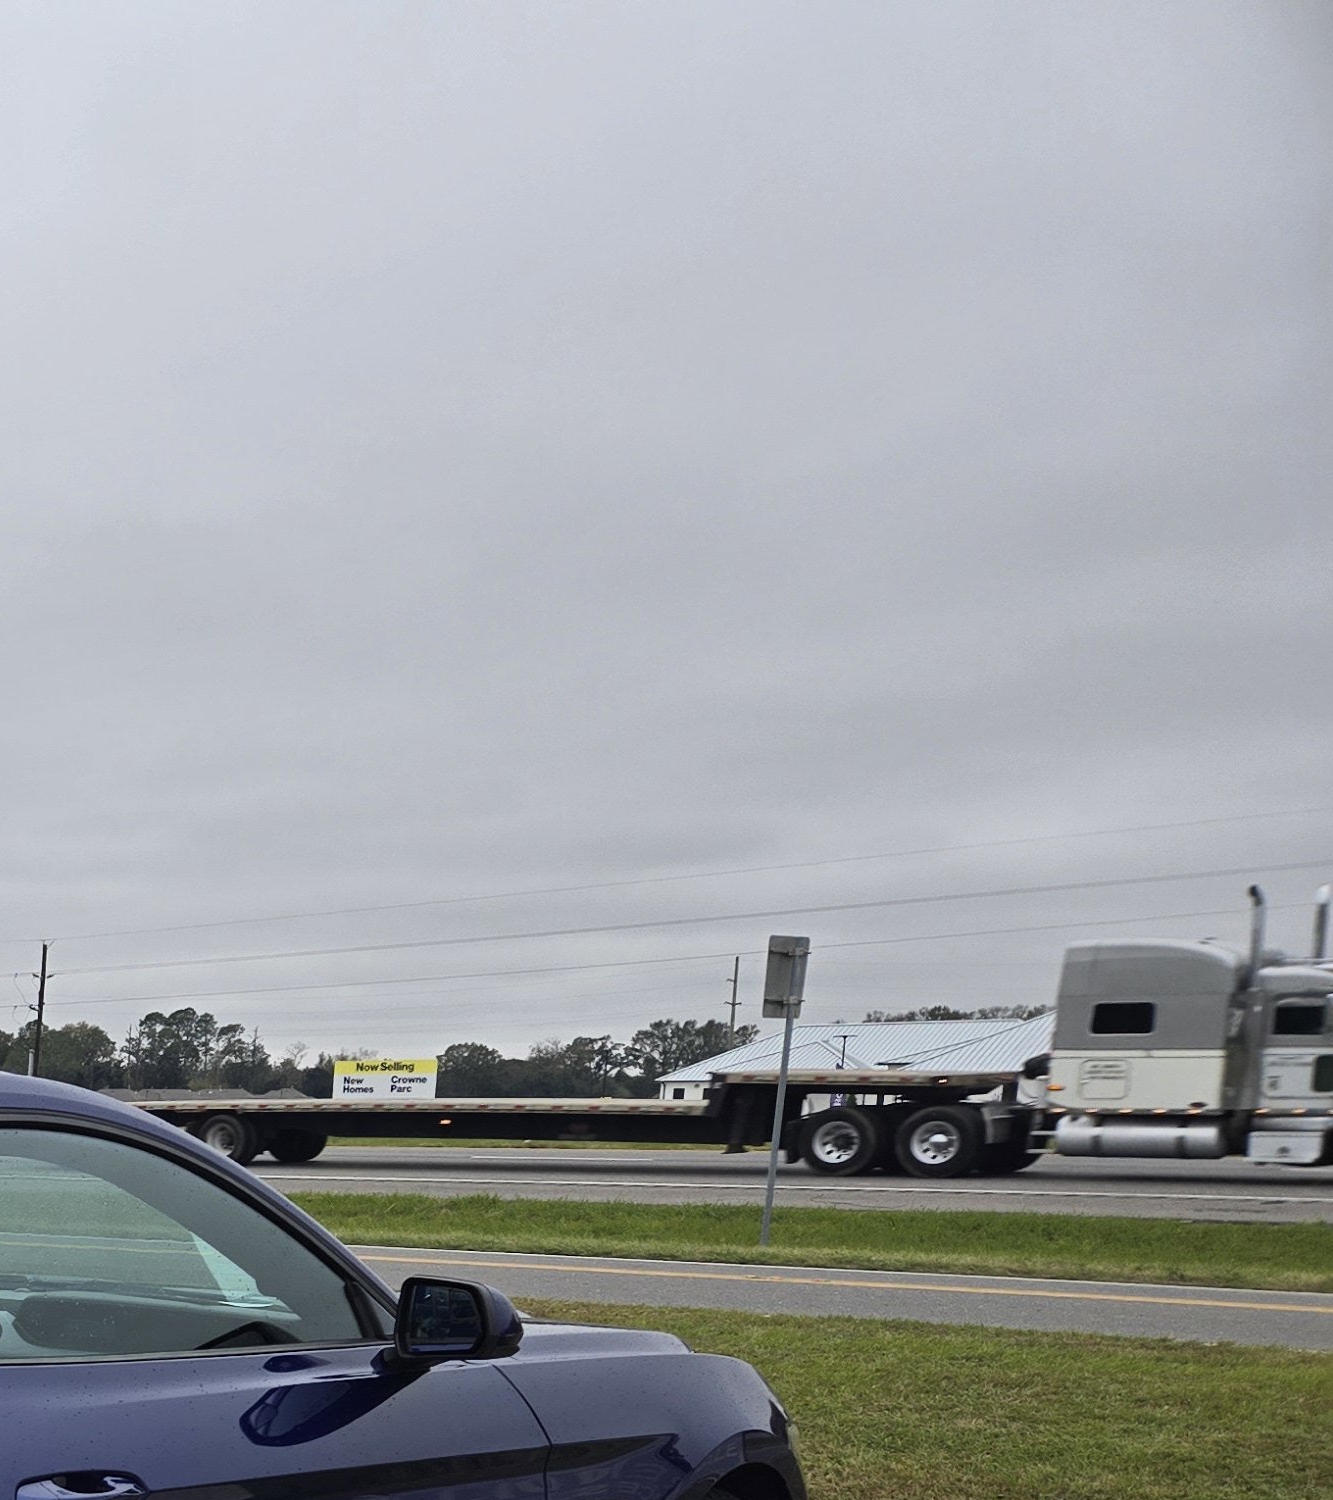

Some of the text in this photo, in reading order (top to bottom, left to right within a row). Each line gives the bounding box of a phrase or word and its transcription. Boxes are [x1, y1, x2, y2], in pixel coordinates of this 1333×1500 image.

[356, 1061, 414, 1073] Now Selling
[343, 1076, 364, 1085] New
[391, 1075, 427, 1084] Crowne
[343, 1085, 374, 1093] Homes
[390, 1084, 412, 1093] Parc
